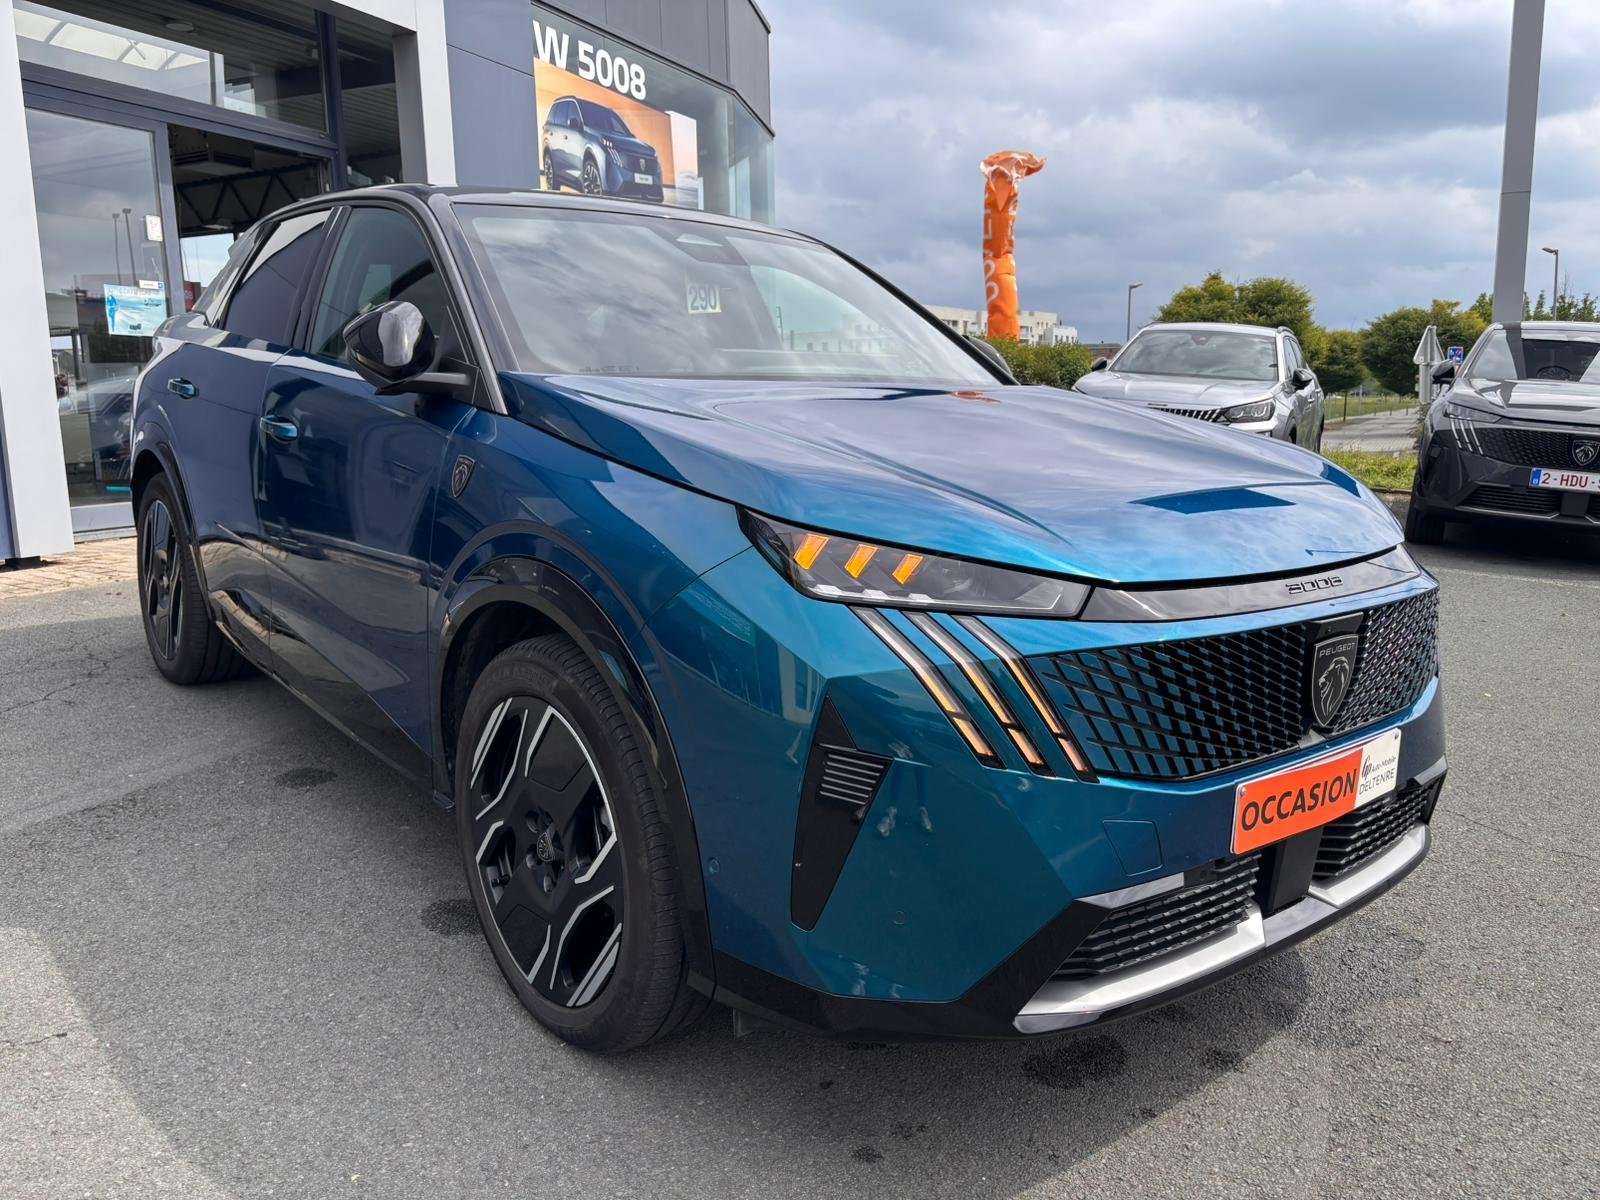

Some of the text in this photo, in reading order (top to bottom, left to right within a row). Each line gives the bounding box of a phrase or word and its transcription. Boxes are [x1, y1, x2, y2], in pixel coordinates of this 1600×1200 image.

[577, 40, 647, 100] 5008
[689, 287, 717, 310] 290
[1319, 642, 1356, 658] PEUGEOT
[1358, 767, 1396, 795] DELTENRE
[1241, 768, 1358, 832] OCCASION
